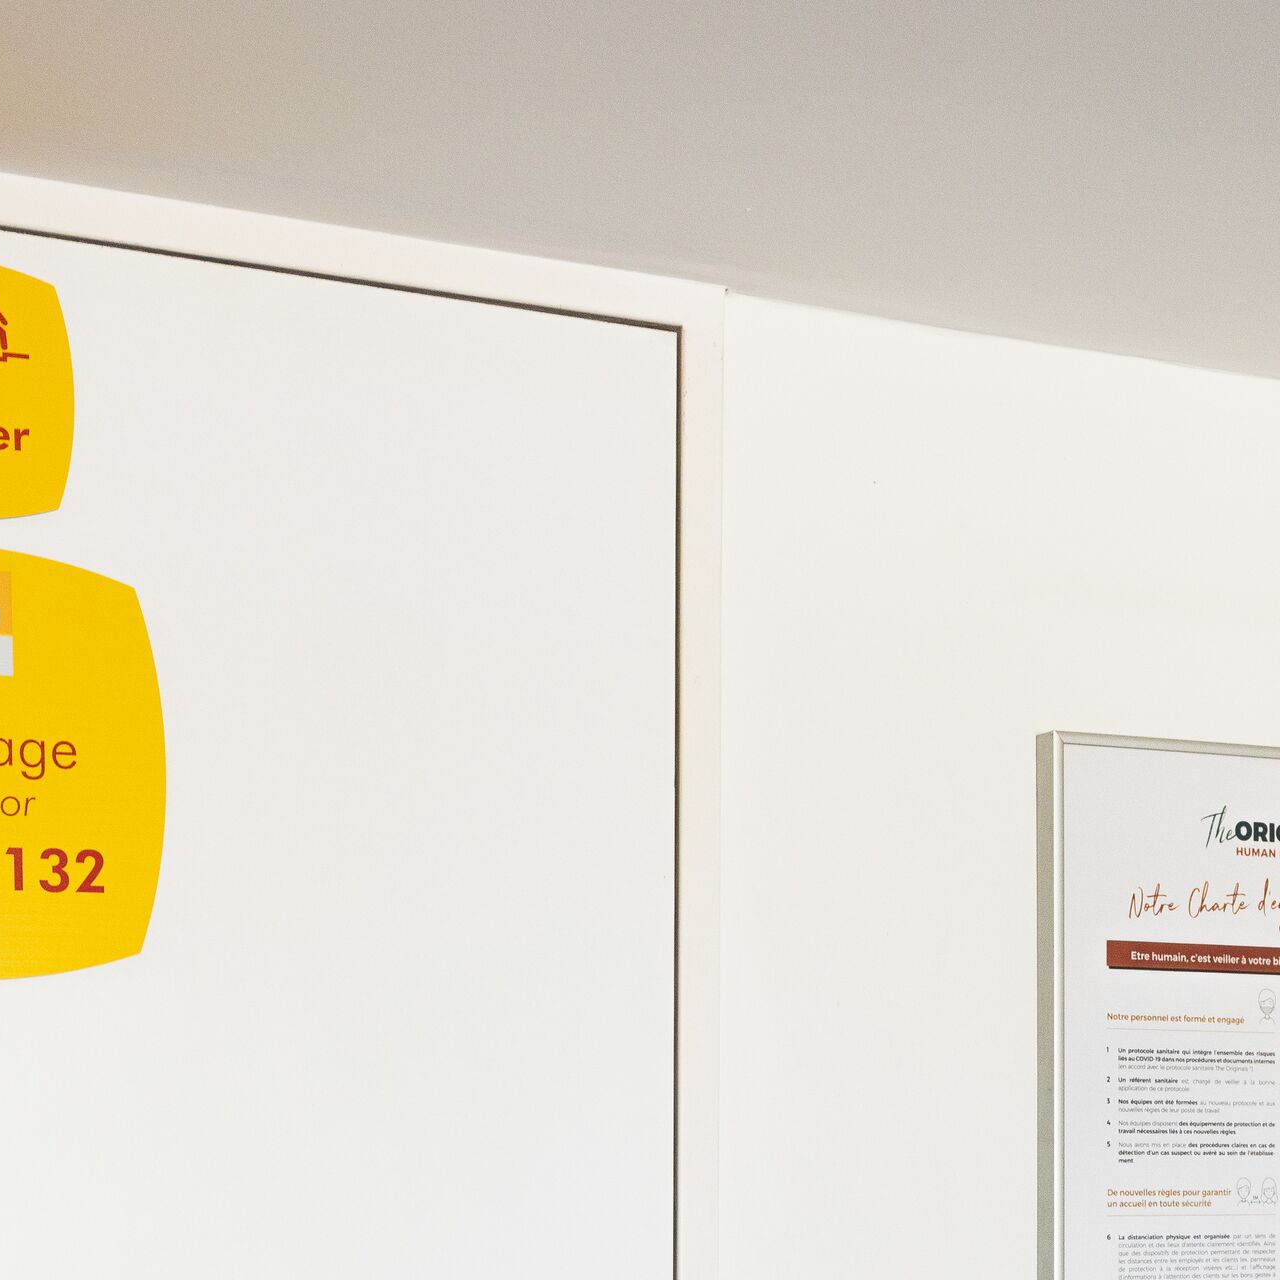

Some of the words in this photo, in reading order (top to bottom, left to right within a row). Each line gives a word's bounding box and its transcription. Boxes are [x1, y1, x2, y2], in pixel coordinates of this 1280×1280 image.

[1236, 847, 1276, 857] HUMAN
[6, 847, 105, 894] 132
[1128, 883, 1179, 919] Notre
[1188, 882, 1249, 918] Charte
[1131, 950, 1149, 960] Etre
[1152, 951, 1188, 962] humain,
[1212, 953, 1239, 964] veiller
[1241, 954, 1246, 964] à
[1248, 956, 1270, 965] votre
[1106, 1012, 1129, 1020] Notre
[1130, 1013, 1168, 1023] personnel
[1107, 1188, 1118, 1196] De
[1119, 1188, 1156, 1196] nouvelles
[1201, 1188, 1231, 1198] garantir
[1119, 1199, 1146, 1208] accueil
[1181, 1199, 1211, 1207] sécurité
